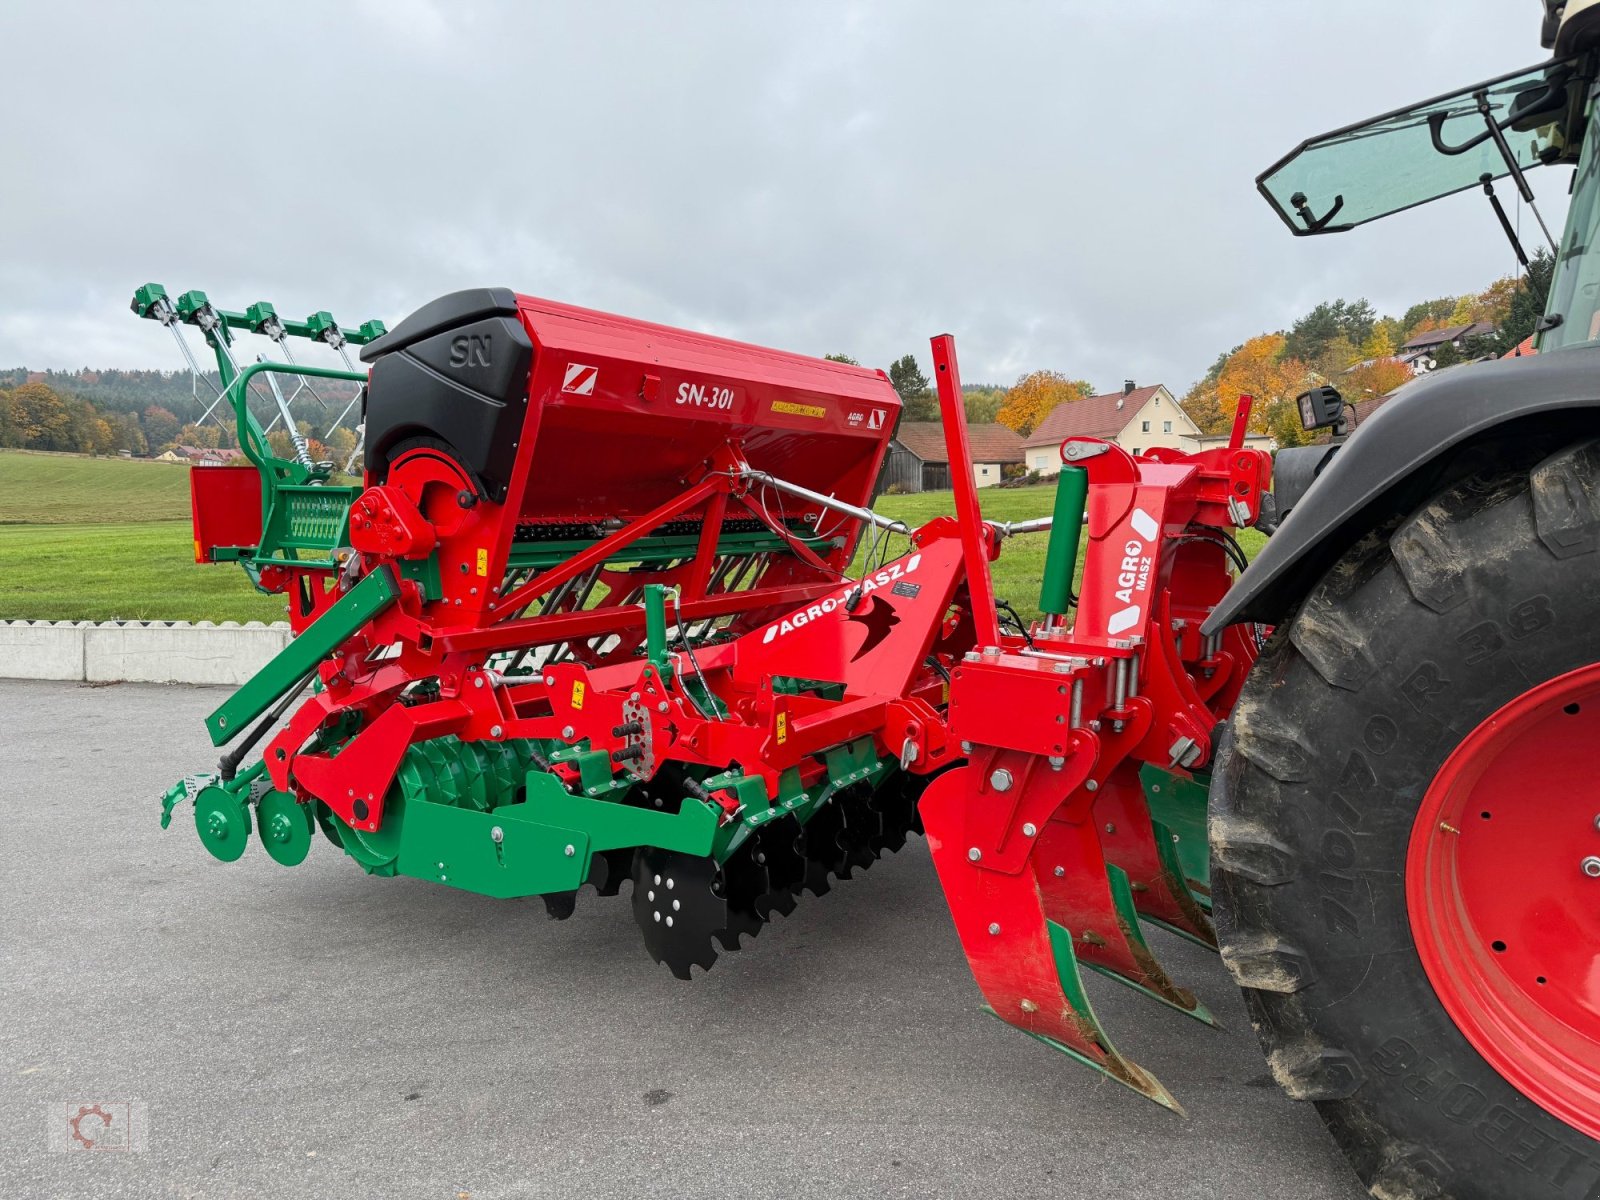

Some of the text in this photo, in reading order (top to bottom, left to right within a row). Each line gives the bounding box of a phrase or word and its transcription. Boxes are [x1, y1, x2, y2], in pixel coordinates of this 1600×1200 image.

[449, 334, 492, 368] SN
[675, 382, 735, 410] SN-301
[1115, 540, 1143, 604] AGRO
[1135, 556, 1152, 591] MASZ
[1400, 660, 1451, 714] R
[1455, 592, 1557, 666] 38
